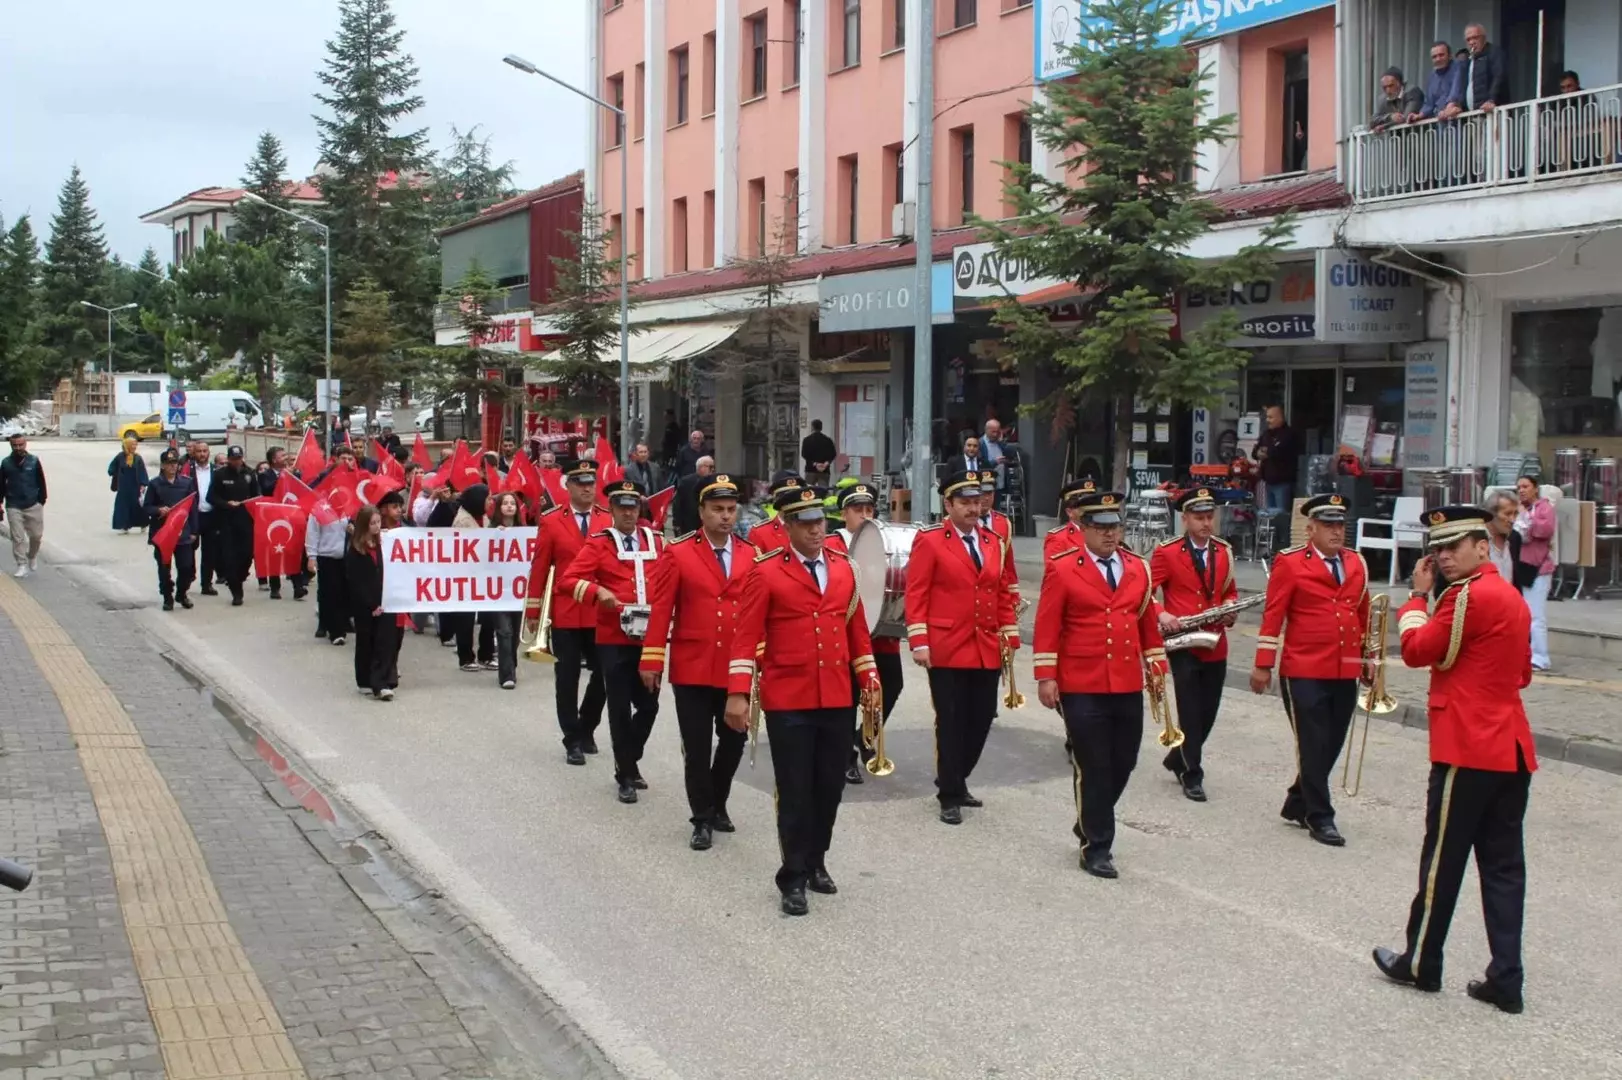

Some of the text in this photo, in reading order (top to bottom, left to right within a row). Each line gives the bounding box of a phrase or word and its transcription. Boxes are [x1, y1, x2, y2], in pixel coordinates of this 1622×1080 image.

[1044, 60, 1054, 72] AK
[1349, 295, 1395, 311] TİCARET
[1243, 316, 1316, 334] PROFİL
[390, 531, 480, 563] AHİLİK
[416, 577, 503, 602] KUTLU
